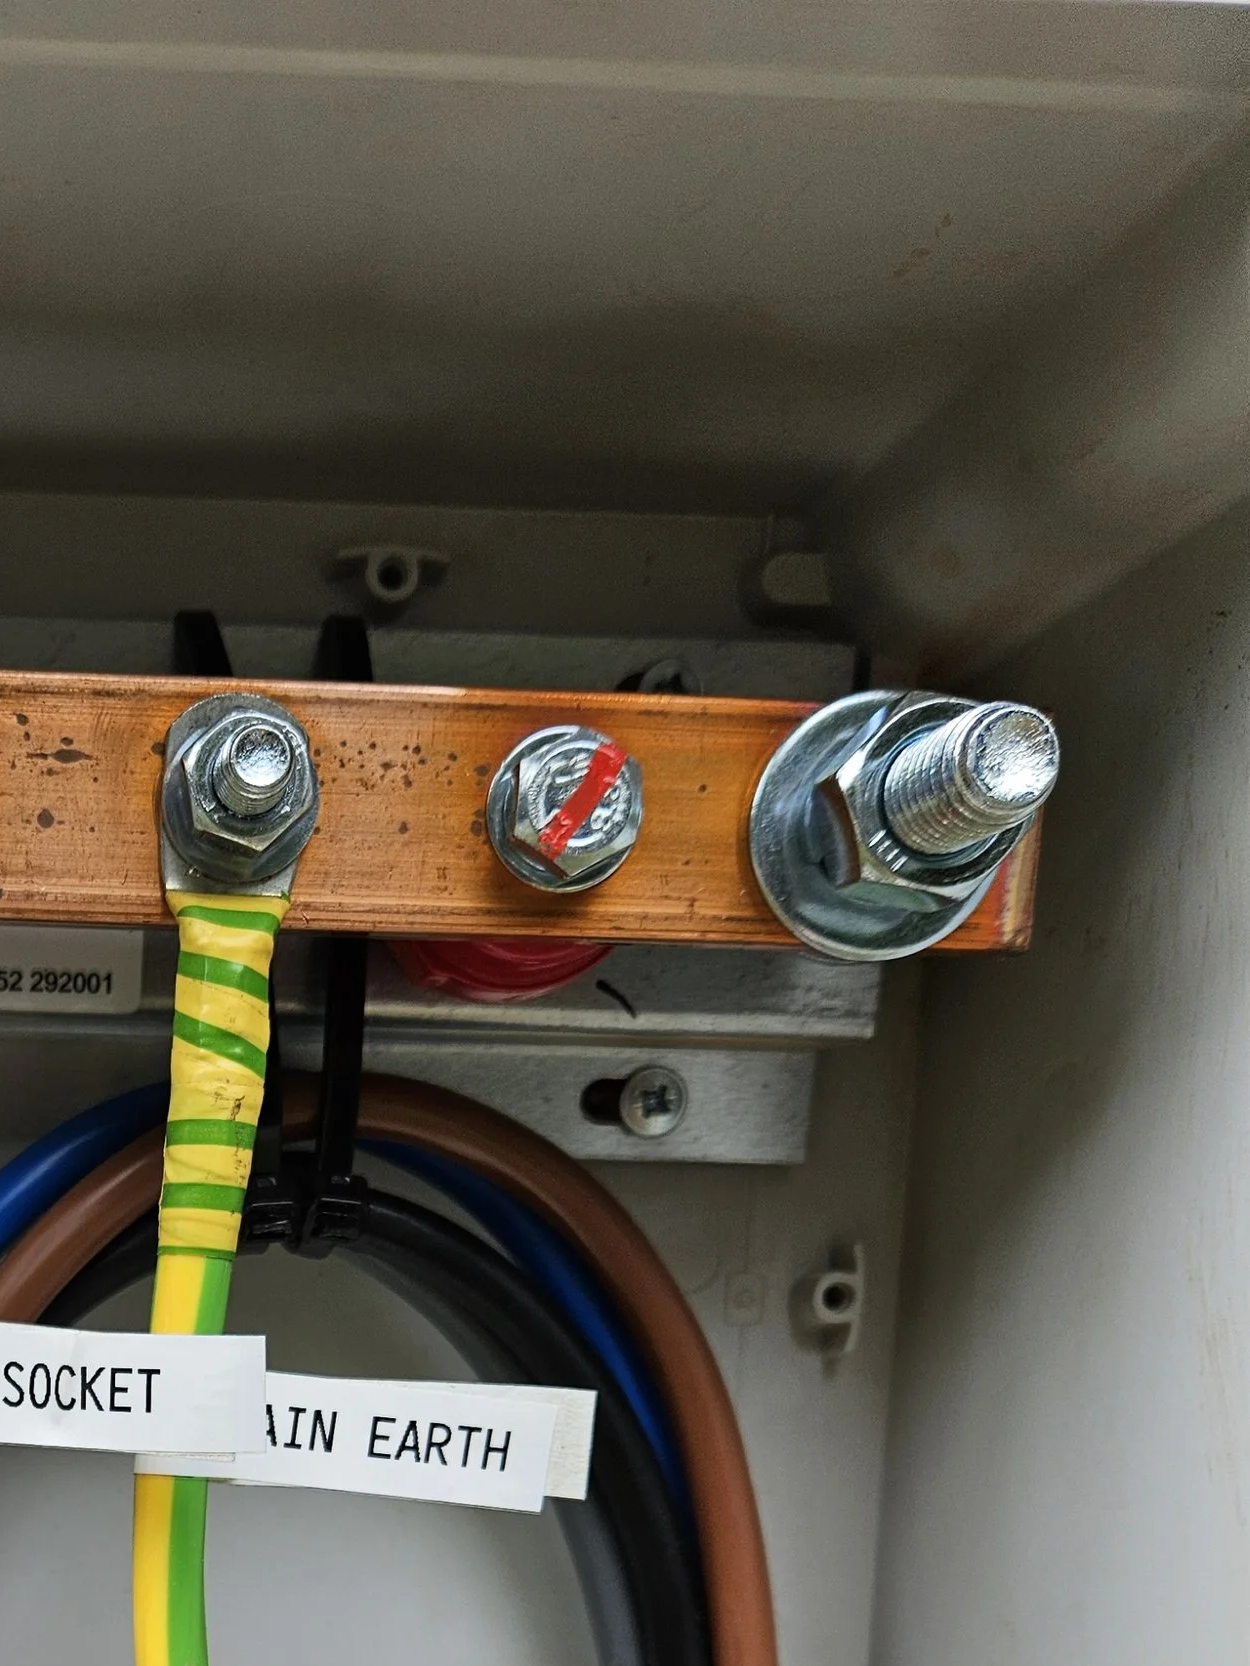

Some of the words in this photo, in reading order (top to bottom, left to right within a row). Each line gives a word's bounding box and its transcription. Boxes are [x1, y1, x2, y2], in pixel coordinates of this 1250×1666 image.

[29, 970, 114, 995] 292001
[2, 1361, 161, 1413] SOCKET
[266, 1404, 338, 1453] AIN
[367, 1416, 512, 1472] EARTH
